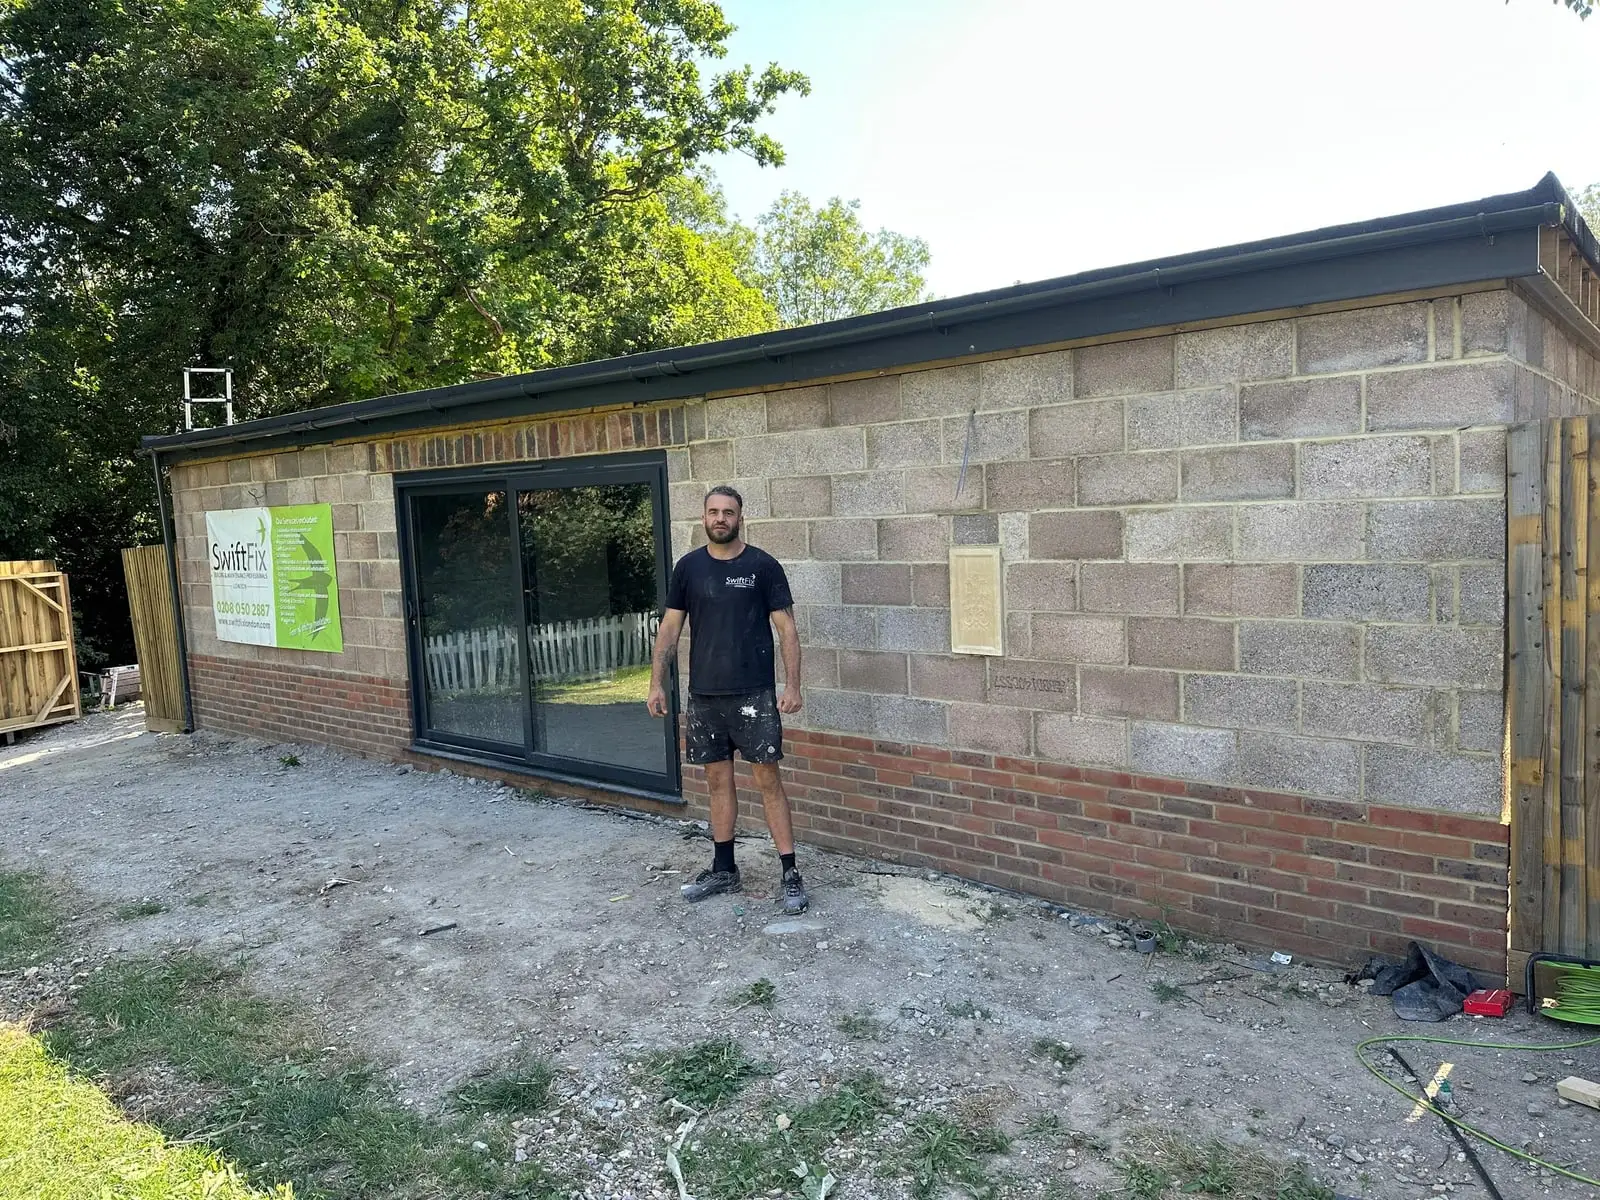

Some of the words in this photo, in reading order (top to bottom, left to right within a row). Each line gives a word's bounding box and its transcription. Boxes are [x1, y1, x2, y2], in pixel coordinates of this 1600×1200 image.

[212, 541, 267, 571] SwiftFix
[725, 576, 755, 585] SwiftFix
[217, 601, 234, 614] 0208
[235, 602, 250, 616] 050
[252, 603, 270, 617] 2887
[218, 618, 271, 630] www.swiftfixlondon.com
